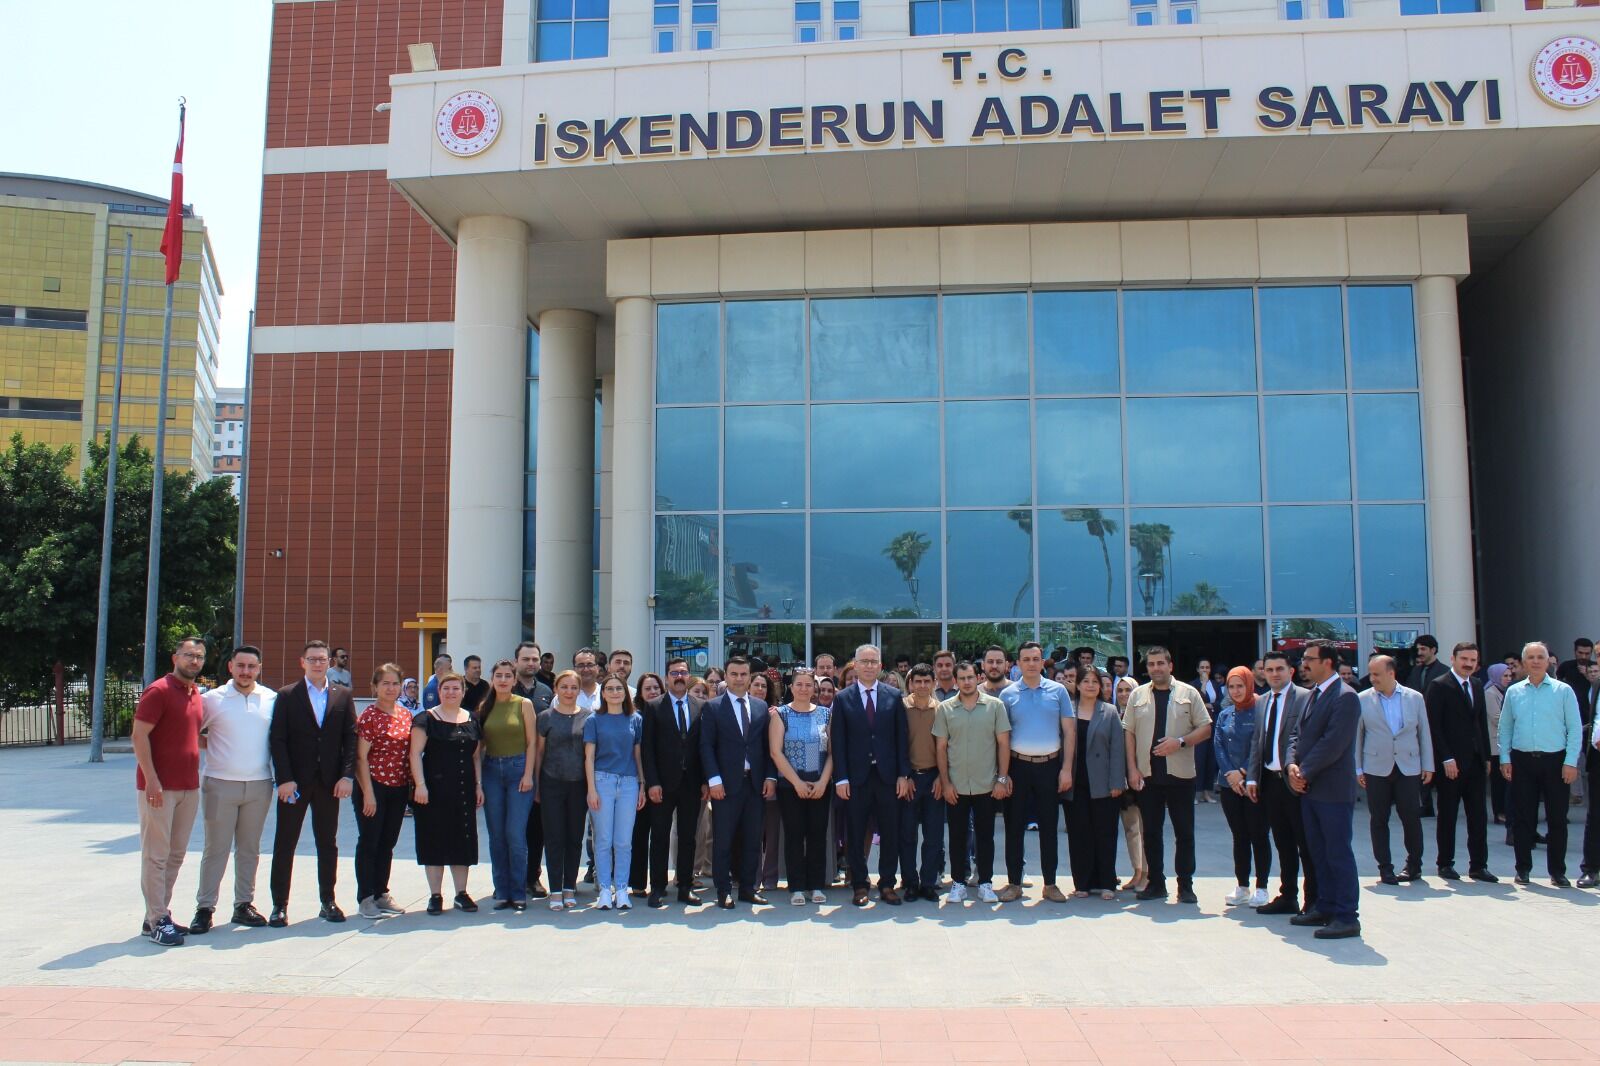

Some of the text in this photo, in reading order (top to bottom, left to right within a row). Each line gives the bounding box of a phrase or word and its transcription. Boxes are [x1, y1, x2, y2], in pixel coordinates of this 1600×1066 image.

[942, 48, 1053, 82] T.C.
[534, 99, 945, 164] İSKENDERUN
[970, 88, 1232, 139] ADALET
[1257, 79, 1501, 130] SARAYI
